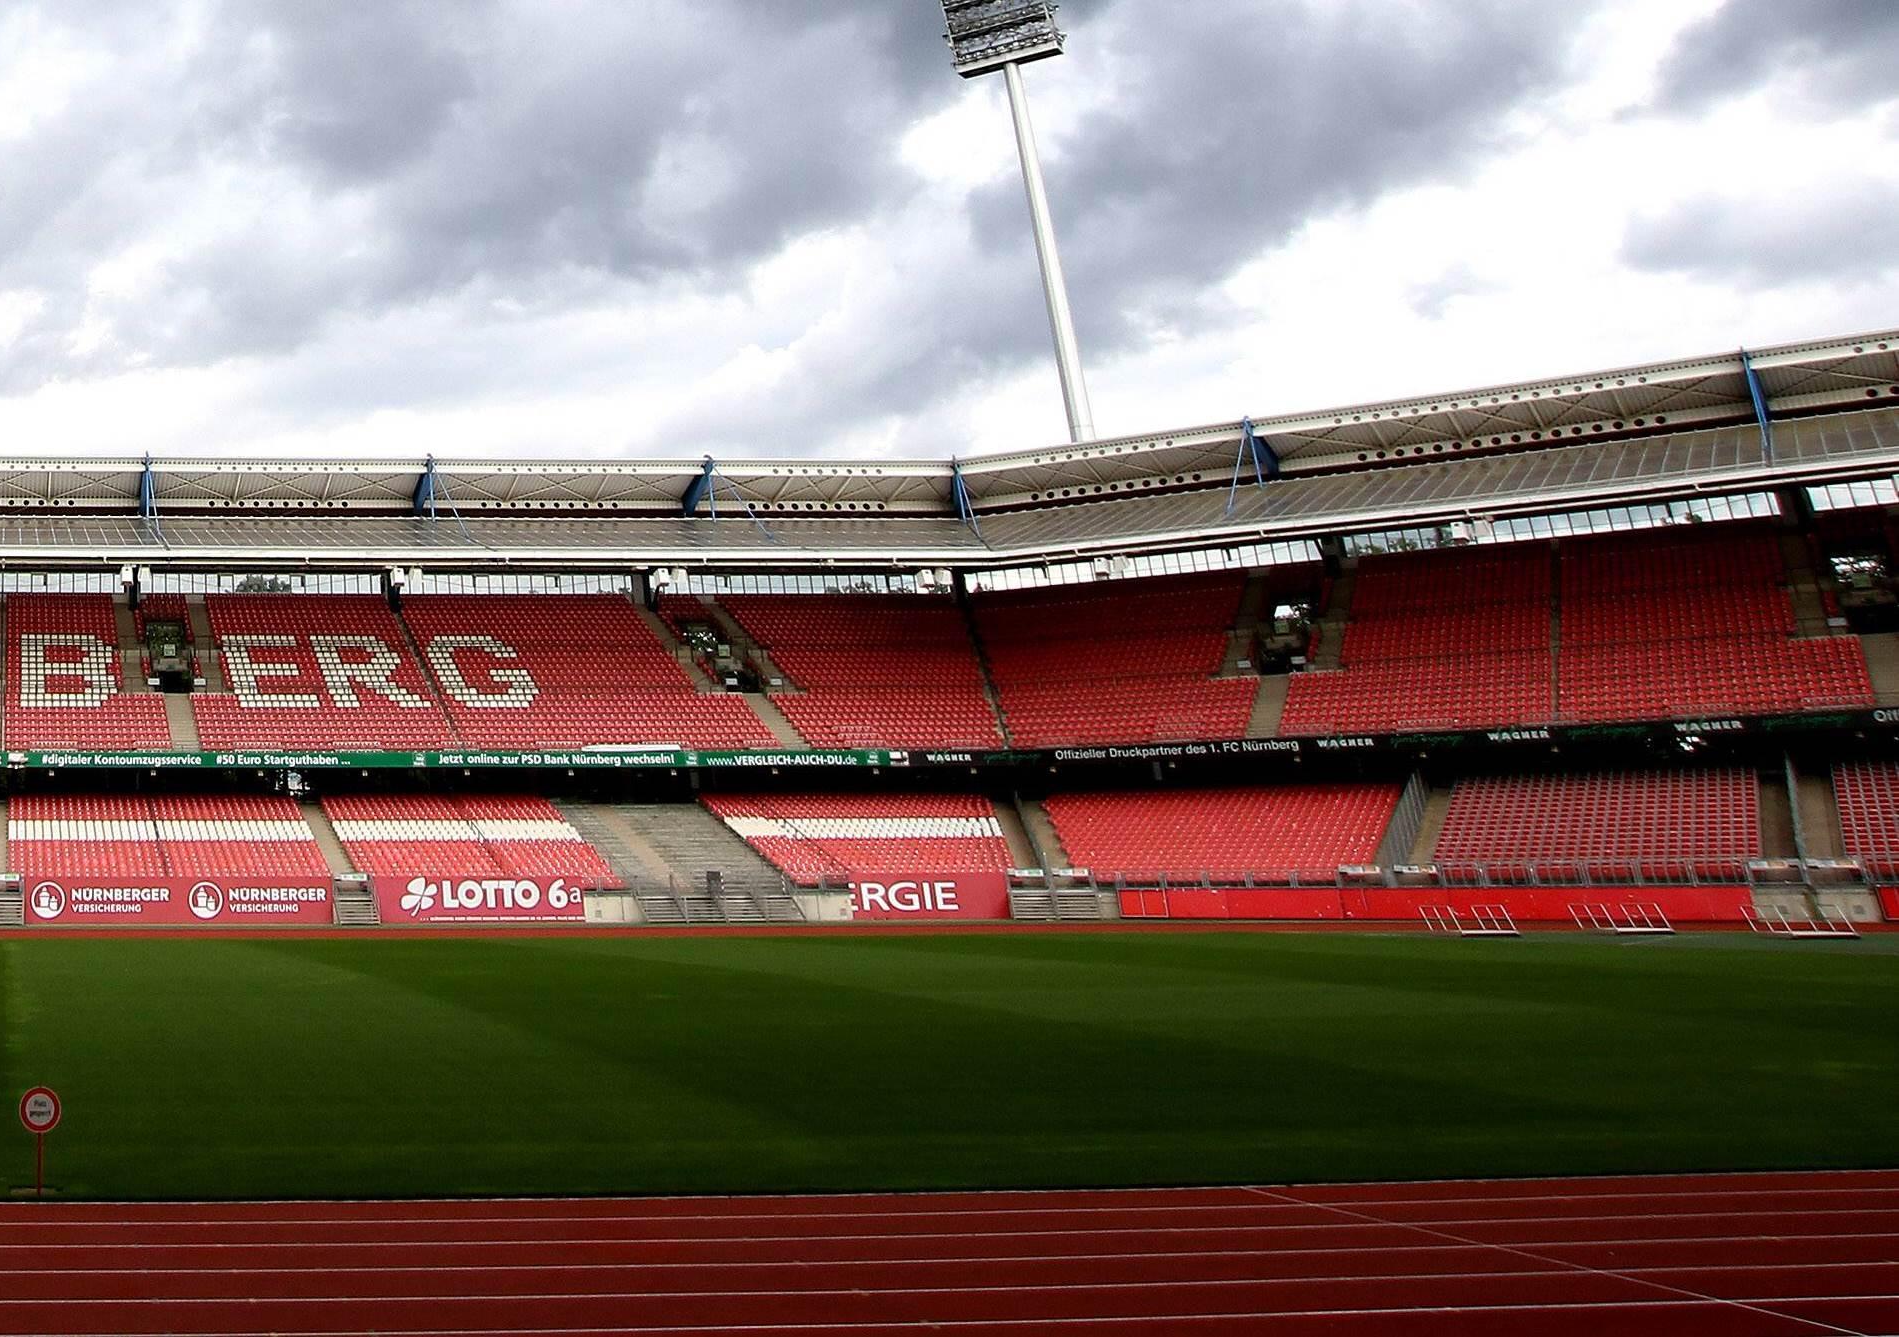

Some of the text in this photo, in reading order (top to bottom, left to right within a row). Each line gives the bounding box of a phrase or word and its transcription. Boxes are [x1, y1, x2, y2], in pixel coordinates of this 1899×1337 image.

[1673, 720, 1741, 733] WAGNER
[1486, 729, 1551, 742] WAGNER
[1055, 748, 1106, 761] Offizieller
[1109, 743, 1185, 761] Druckpartner
[1187, 743, 1206, 757] des
[1223, 742, 1238, 753] FC
[1240, 737, 1299, 754] Nürnberg
[1316, 737, 1375, 749] WAGNER
[42, 753, 202, 767] #digitaler Kontoumzugsservice
[216, 753, 234, 766] #50
[236, 753, 261, 766] Euro
[263, 753, 338, 767] Startguthaben
[438, 752, 465, 766] Jetzt
[467, 752, 499, 766] online
[502, 754, 518, 766] zur
[520, 752, 542, 766] PSD
[544, 752, 570, 766] Bank
[572, 752, 622, 768] Nürnberg
[623, 752, 675, 766] wechseln!
[706, 753, 857, 768] www.VERGLEICH-AUCH-DU.de
[926, 753, 972, 762] WAGNER
[71, 886, 169, 902] NÜRNBERGER
[228, 886, 326, 902] NÜRNBERGER
[442, 879, 540, 909] LOTTO
[71, 903, 142, 913] VERSICHERUNG
[229, 903, 298, 913] VERSICHERUNG
